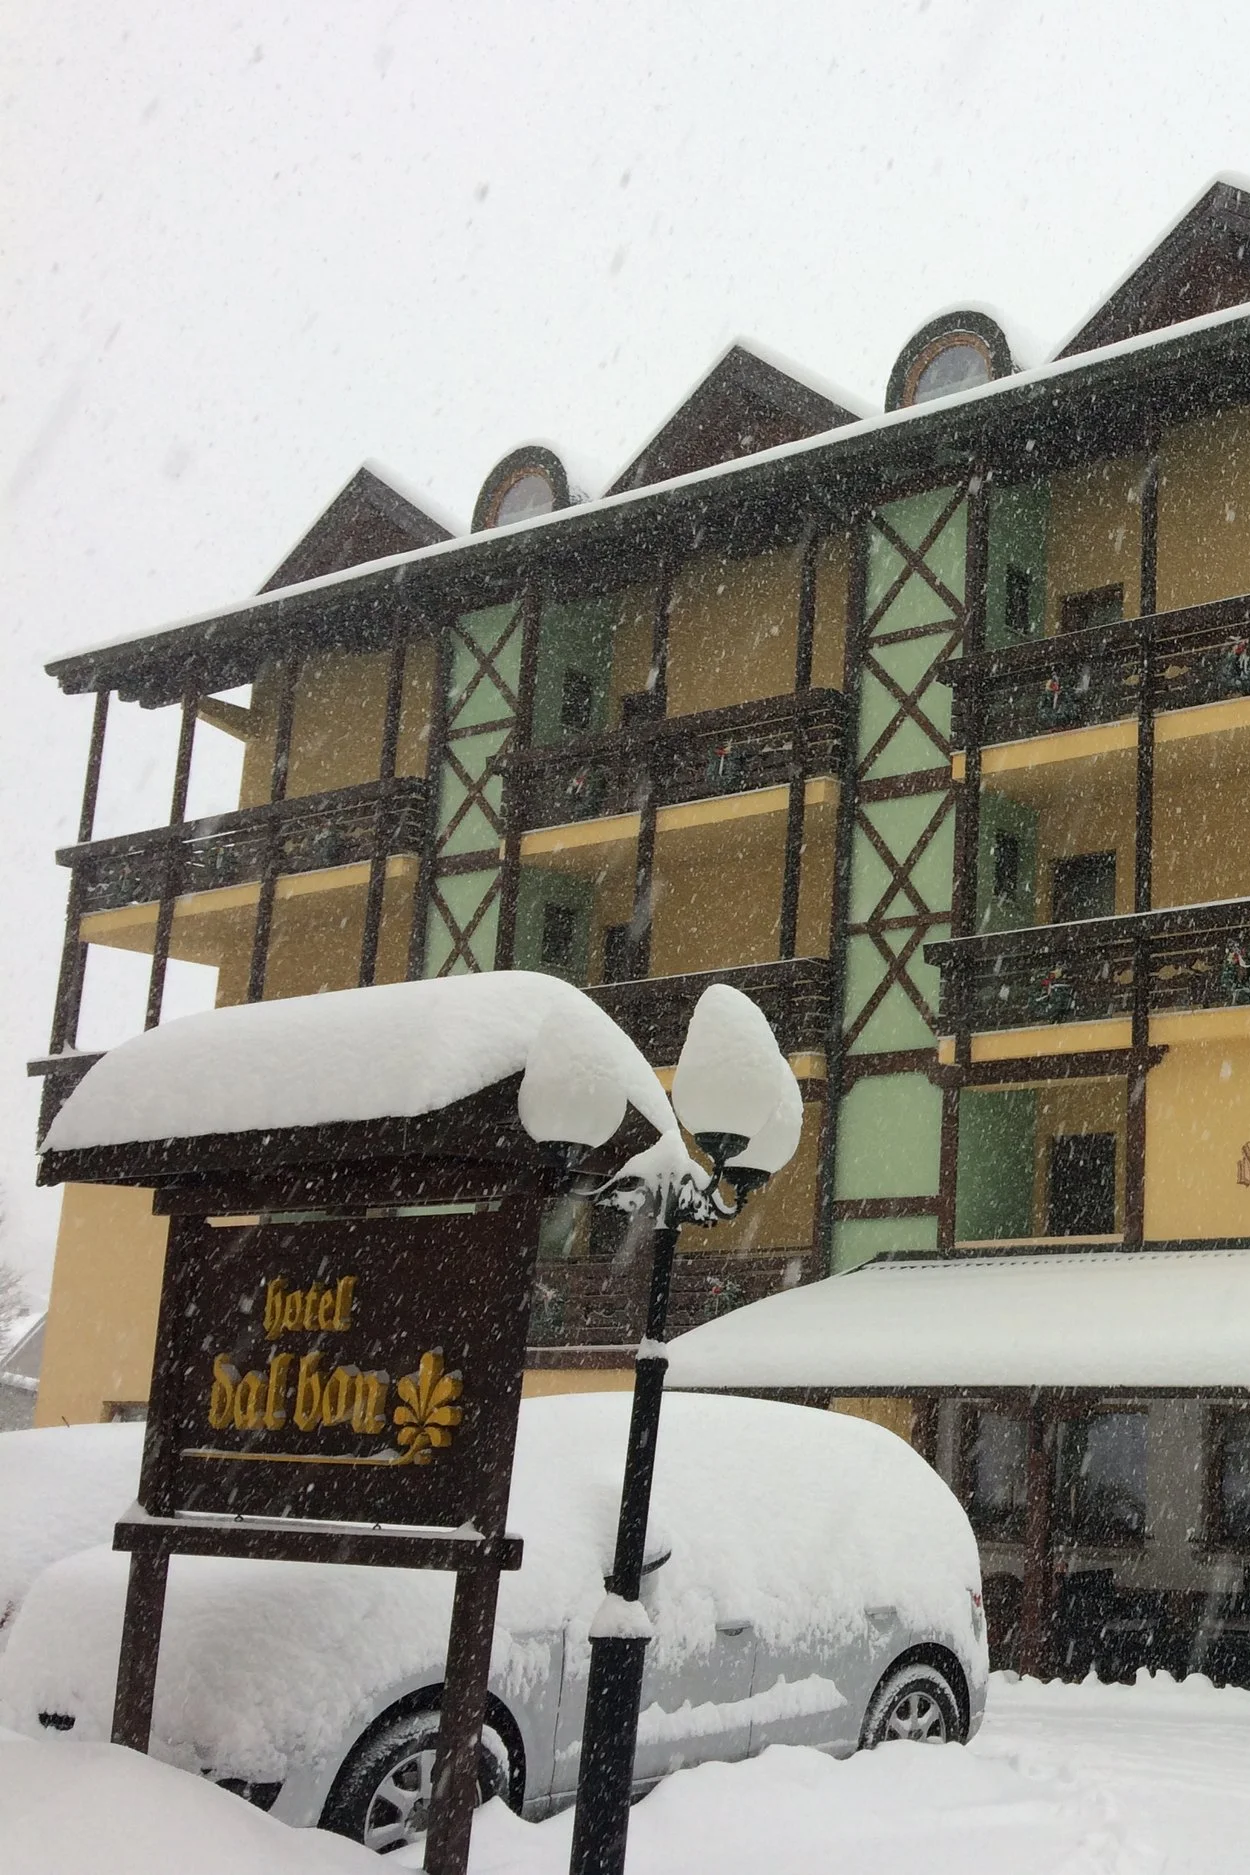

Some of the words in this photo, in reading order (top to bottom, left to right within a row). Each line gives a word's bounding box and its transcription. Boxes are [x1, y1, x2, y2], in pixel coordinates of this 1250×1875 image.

[263, 1275, 358, 1340] hotel
[208, 1352, 294, 1430] dal
[294, 1351, 390, 1434] bon
